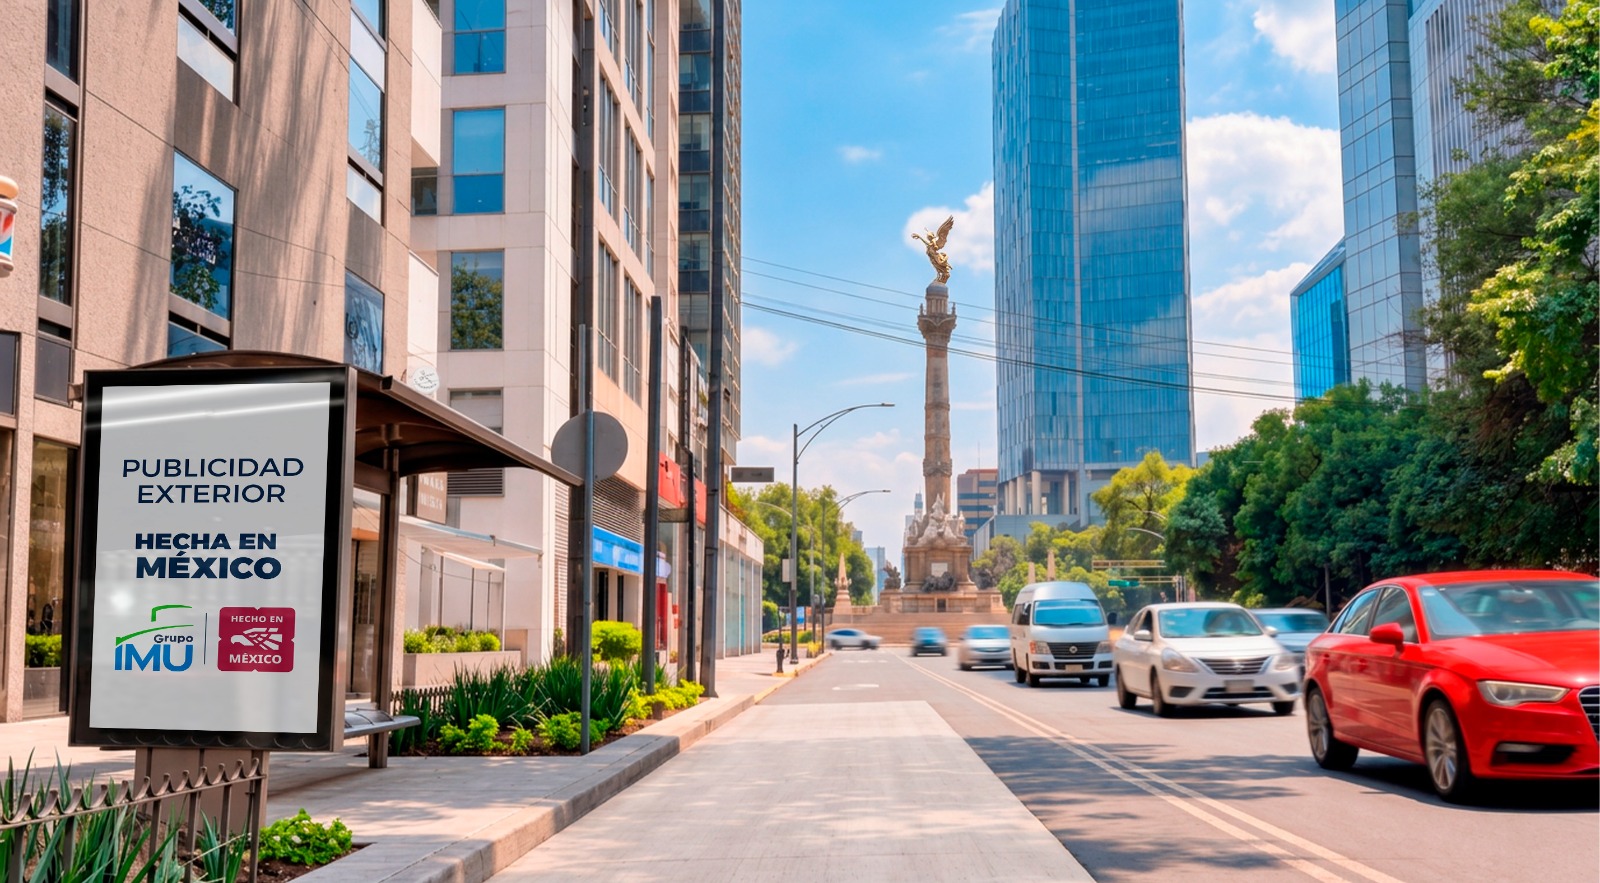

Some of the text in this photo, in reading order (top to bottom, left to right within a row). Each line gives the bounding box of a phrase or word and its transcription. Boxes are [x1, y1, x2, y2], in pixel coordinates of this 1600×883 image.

[122, 457, 304, 478] PUBLICIDAD
[137, 483, 286, 504] EXTERIOR
[135, 532, 277, 550] HECHA EN
[136, 551, 282, 580] MÉXICO
[231, 615, 284, 623] HECHO EN
[153, 634, 194, 644] Grupo
[114, 644, 193, 672] IMU
[229, 652, 282, 664] MÉXICO
